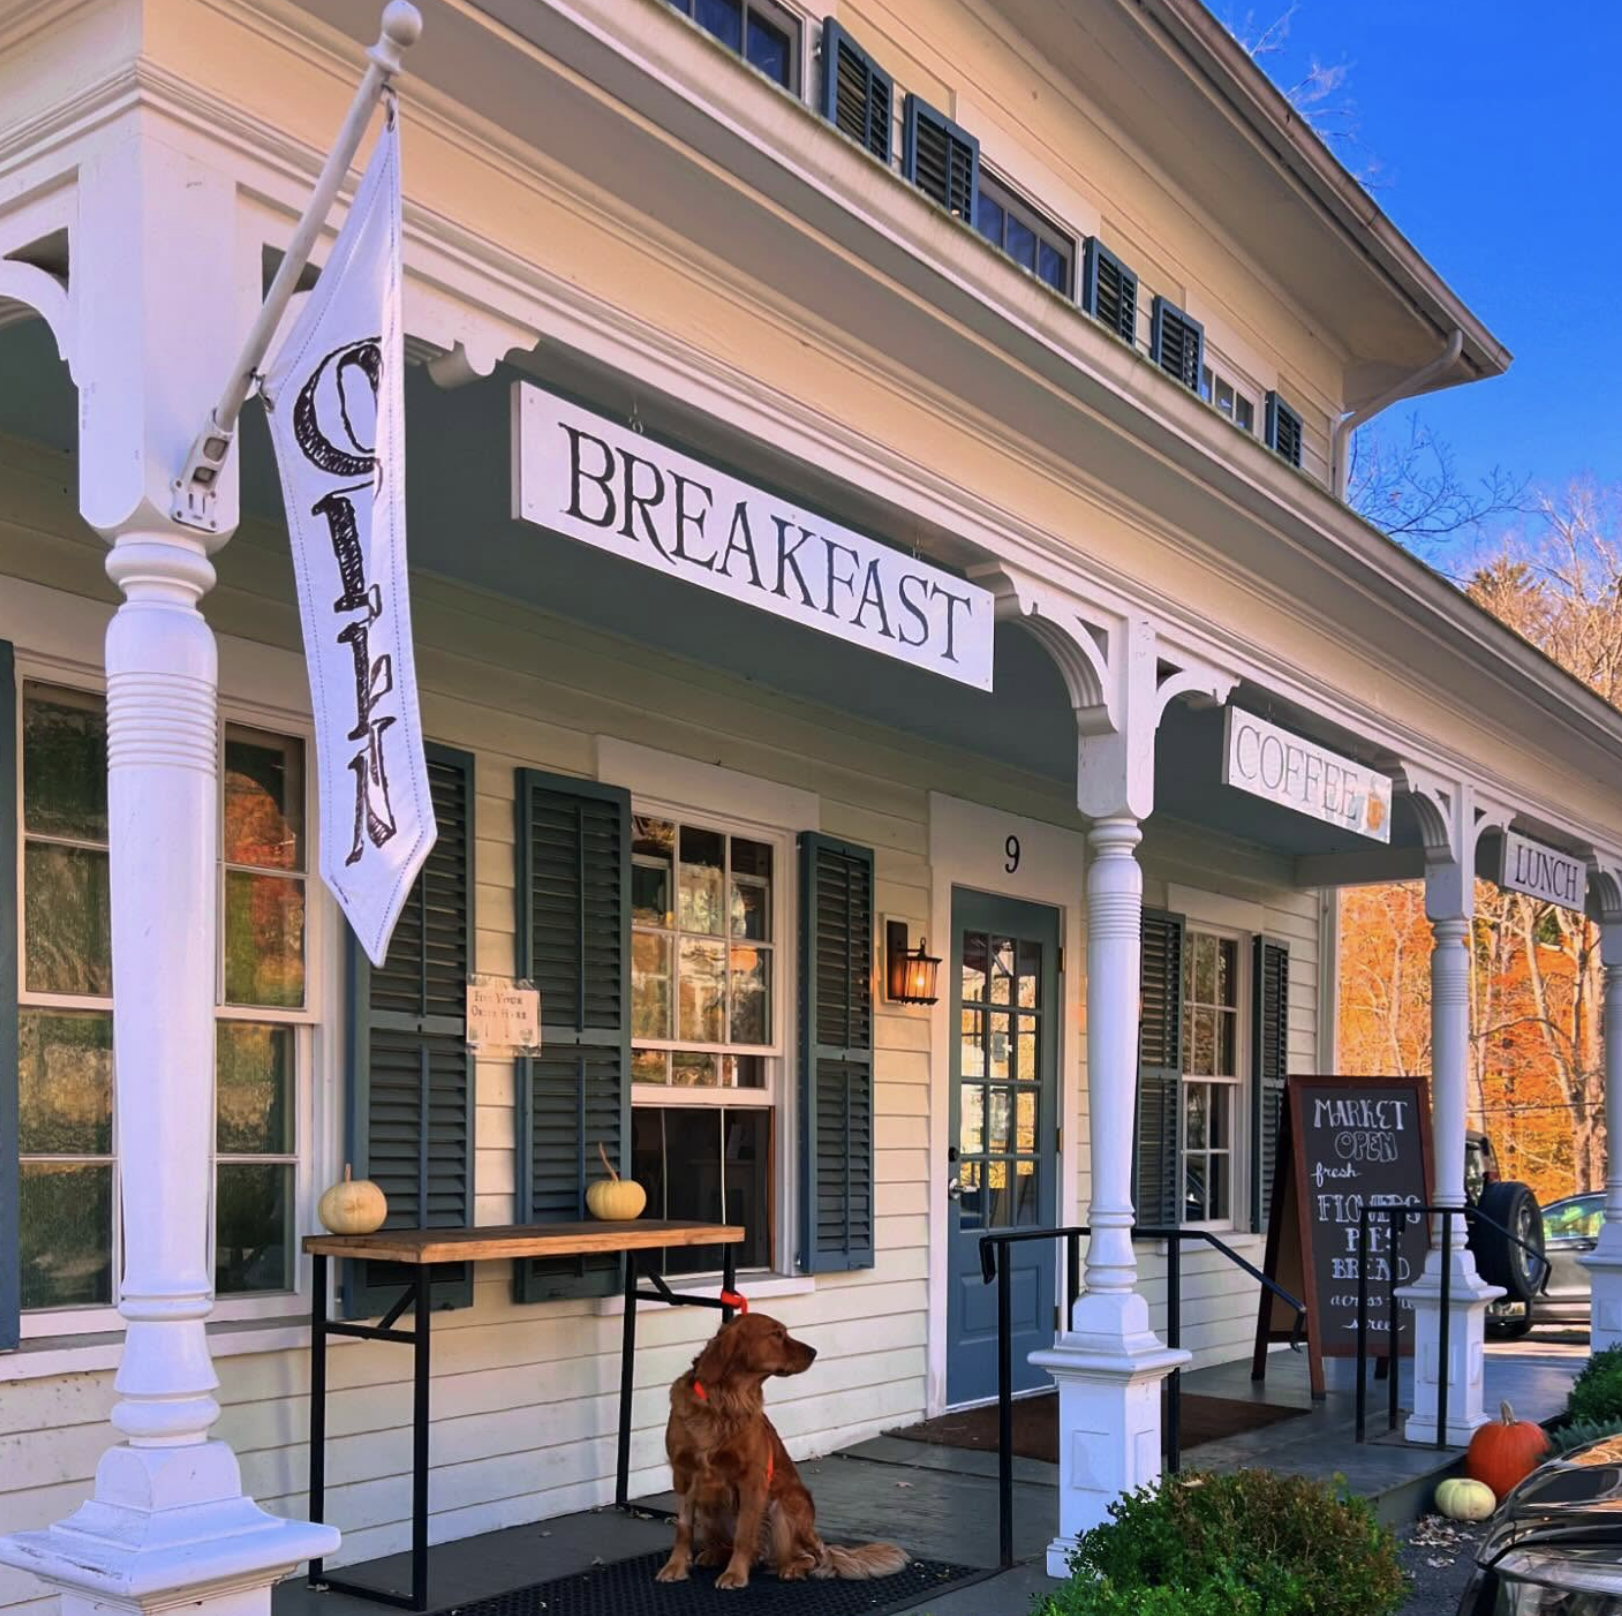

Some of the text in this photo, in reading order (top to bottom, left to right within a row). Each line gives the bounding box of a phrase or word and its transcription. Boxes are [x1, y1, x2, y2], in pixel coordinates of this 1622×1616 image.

[557, 421, 972, 664] BREAKFAST
[1236, 725, 1359, 820] COFFEE
[1004, 834, 1020, 874] 9
[1514, 844, 1579, 902] LUNCH
[1313, 1098, 1408, 1131] MARKET
[1334, 1131, 1399, 1163] OPEN
[1310, 1161, 1363, 1188] fresh
[1344, 1227, 1401, 1252] PES
[1330, 1294, 1384, 1308] acrss
